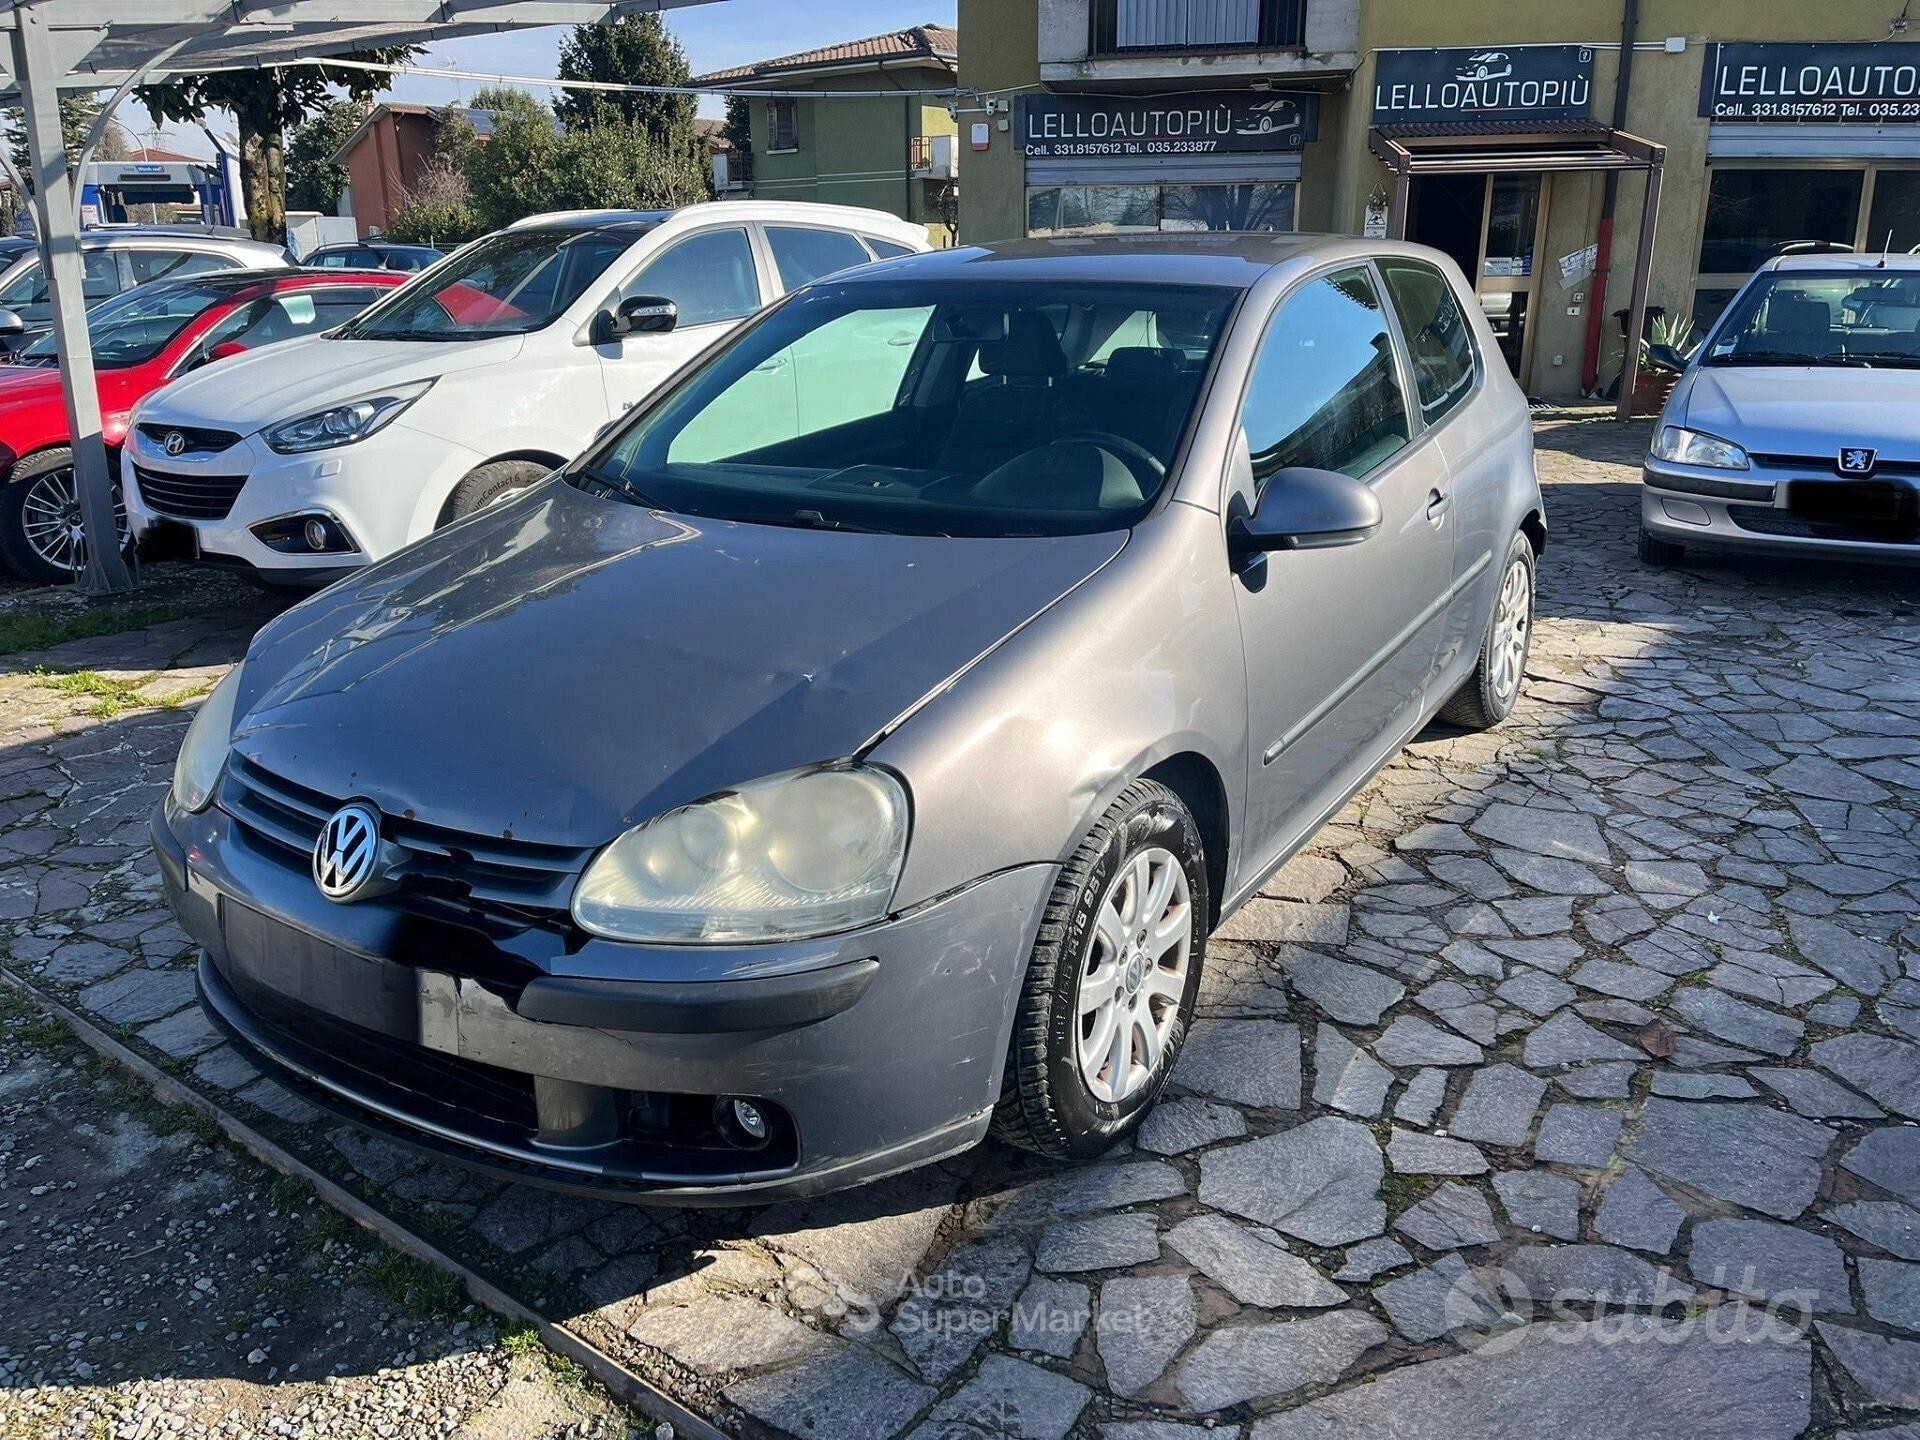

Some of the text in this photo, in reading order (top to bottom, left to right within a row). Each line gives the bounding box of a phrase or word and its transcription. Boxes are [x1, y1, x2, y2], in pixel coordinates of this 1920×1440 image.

[1375, 73, 1589, 110] LELLOAUTOPIÙ
[1719, 65, 1920, 96] LELLOAUTO
[1029, 103, 1231, 138] LELLOAUTOPIÙ
[1715, 103, 1745, 116] Cell.
[1751, 103, 1836, 116] 331.8157612
[1840, 103, 1863, 116] Tel.
[1025, 141, 1217, 156] Cell. 331.8157612 Tel. 035.233877
